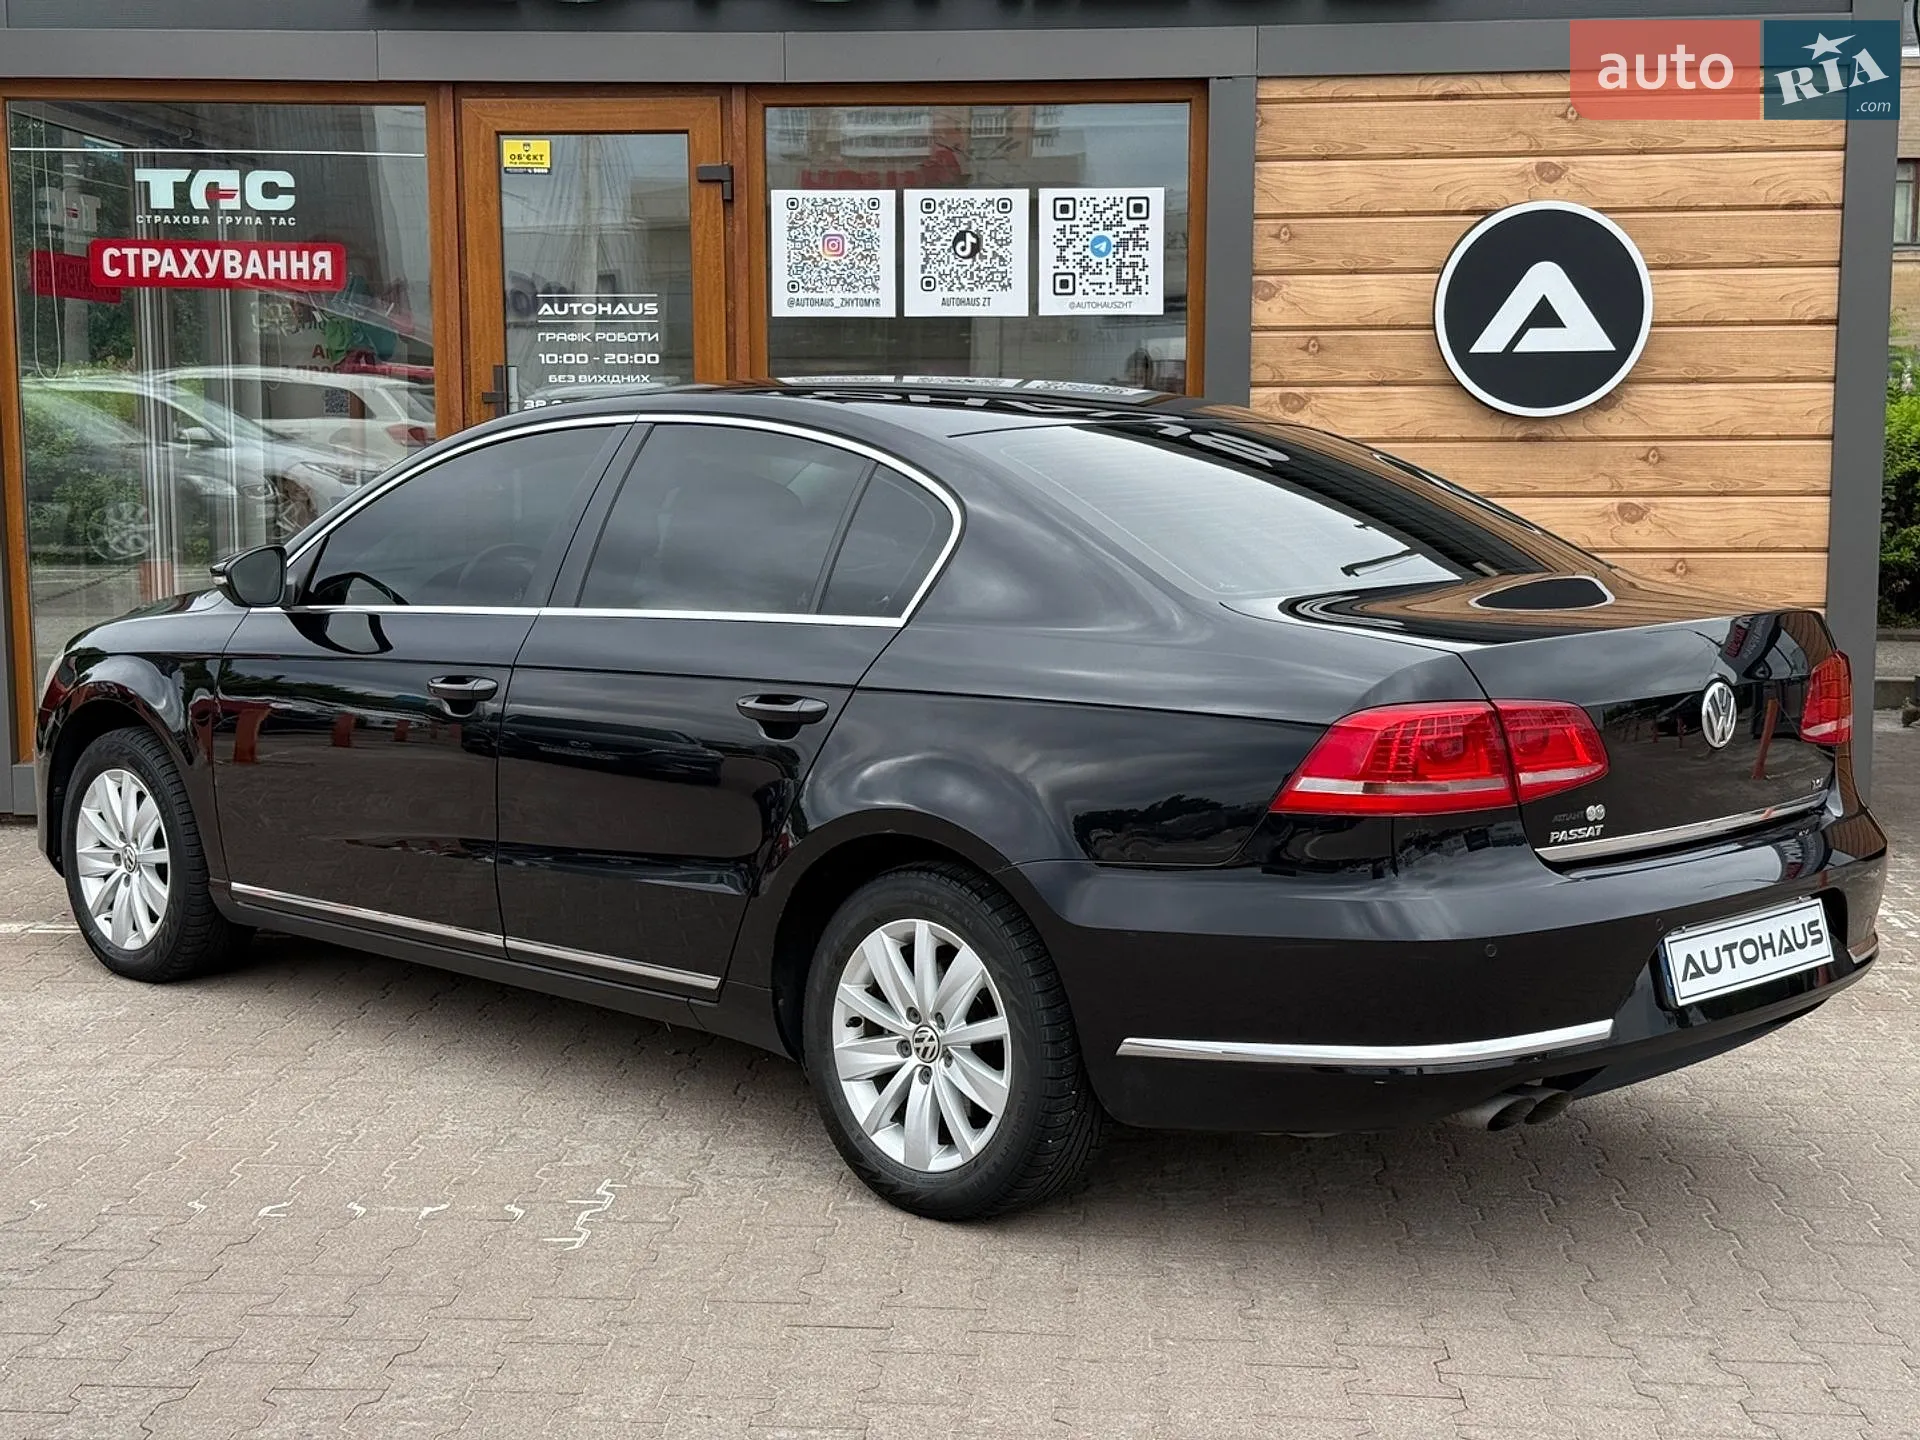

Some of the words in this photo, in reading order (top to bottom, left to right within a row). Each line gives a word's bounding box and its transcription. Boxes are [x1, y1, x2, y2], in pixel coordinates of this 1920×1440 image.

[136, 214, 210, 226] СТРАХОВА
[217, 215, 264, 227] ГРУПА
[270, 216, 297, 227] ТАС
[102, 246, 333, 281] СТРАХУВАННЯ
[786, 296, 881, 309] @AUTOHAUS_ZHYTOMYR
[941, 297, 980, 307] AUTOHAUS
[981, 297, 992, 307] ZT
[537, 303, 659, 316] AUTOHAUS
[537, 332, 592, 343] ГРАФІК
[595, 332, 660, 343] РОБОТИ
[538, 353, 589, 364] 10:00
[603, 353, 660, 364] 20:00
[548, 374, 576, 383] БЕЗ
[578, 374, 651, 384] ВИХІДНИХ
[1549, 824, 1604, 844] PASSAT
[1681, 919, 1824, 983] AUTOHAUS
